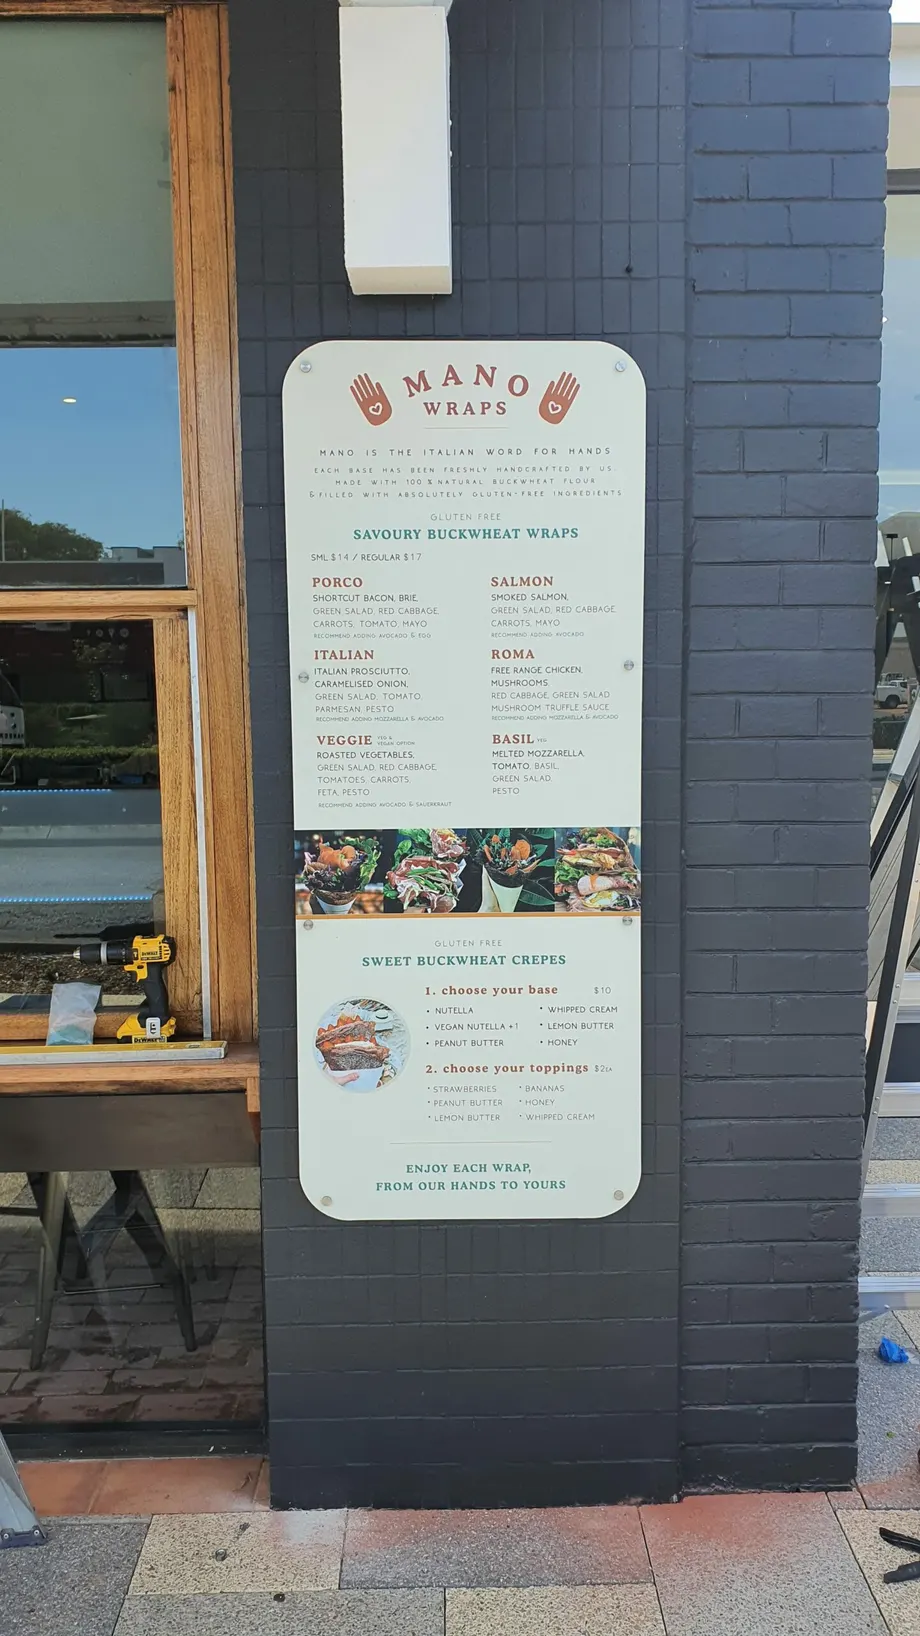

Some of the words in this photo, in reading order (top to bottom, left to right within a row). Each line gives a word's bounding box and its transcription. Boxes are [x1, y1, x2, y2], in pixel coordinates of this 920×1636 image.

[402, 365, 529, 397] MANO
[423, 402, 508, 415] WRAPS
[430, 513, 472, 521] GLUTEN
[353, 529, 421, 539] SAVOURY
[427, 529, 520, 539] BUCKWHEAT
[526, 528, 578, 538] WRAPS
[331, 553, 349, 561] $14
[404, 553, 421, 561] $17
[312, 577, 363, 587] PORCO
[491, 576, 553, 587] SALMON
[313, 594, 360, 602] SHORTCUT
[364, 594, 396, 602] BACON,
[399, 594, 418, 602] BRIE,
[491, 593, 528, 601] SMOKED
[531, 593, 569, 601] SALMON,
[491, 604, 519, 614] GREEN
[313, 620, 355, 628] CARROTS,
[315, 650, 374, 660] ITALIAN
[492, 649, 535, 659] ROMA
[315, 680, 374, 688] CARAMELISED
[365, 705, 395, 713] PESTO
[492, 704, 541, 712] MUSHROOM
[317, 735, 372, 745] VEGGIE
[493, 734, 534, 744] BASIL
[533, 762, 559, 770] BASIL,
[317, 776, 369, 784] TOMATOES,
[492, 773, 520, 782] GREEN
[362, 957, 411, 966] SWEET
[417, 956, 506, 965] BUCKWHEAT
[512, 955, 566, 965] CREPES
[426, 987, 436, 995] 1.
[442, 986, 487, 995] choose
[493, 987, 523, 996] your
[529, 985, 558, 994] base
[426, 1065, 437, 1073] 2.
[443, 1064, 488, 1073] choose
[494, 1066, 524, 1075] your
[530, 1063, 588, 1074] toppings
[433, 1085, 497, 1093] STRAWBERRIES
[525, 1097, 556, 1106] HONEY
[435, 1113, 465, 1121] LEMON
[406, 1164, 448, 1173] ENJOY
[453, 1164, 487, 1172] EACH
[492, 1164, 531, 1173] WRAP,
[376, 1182, 414, 1191] FROM
[418, 1182, 445, 1190] OUR
[451, 1181, 495, 1190] HANDS
[500, 1181, 518, 1189] TO
[523, 1181, 565, 1189] YOURS
